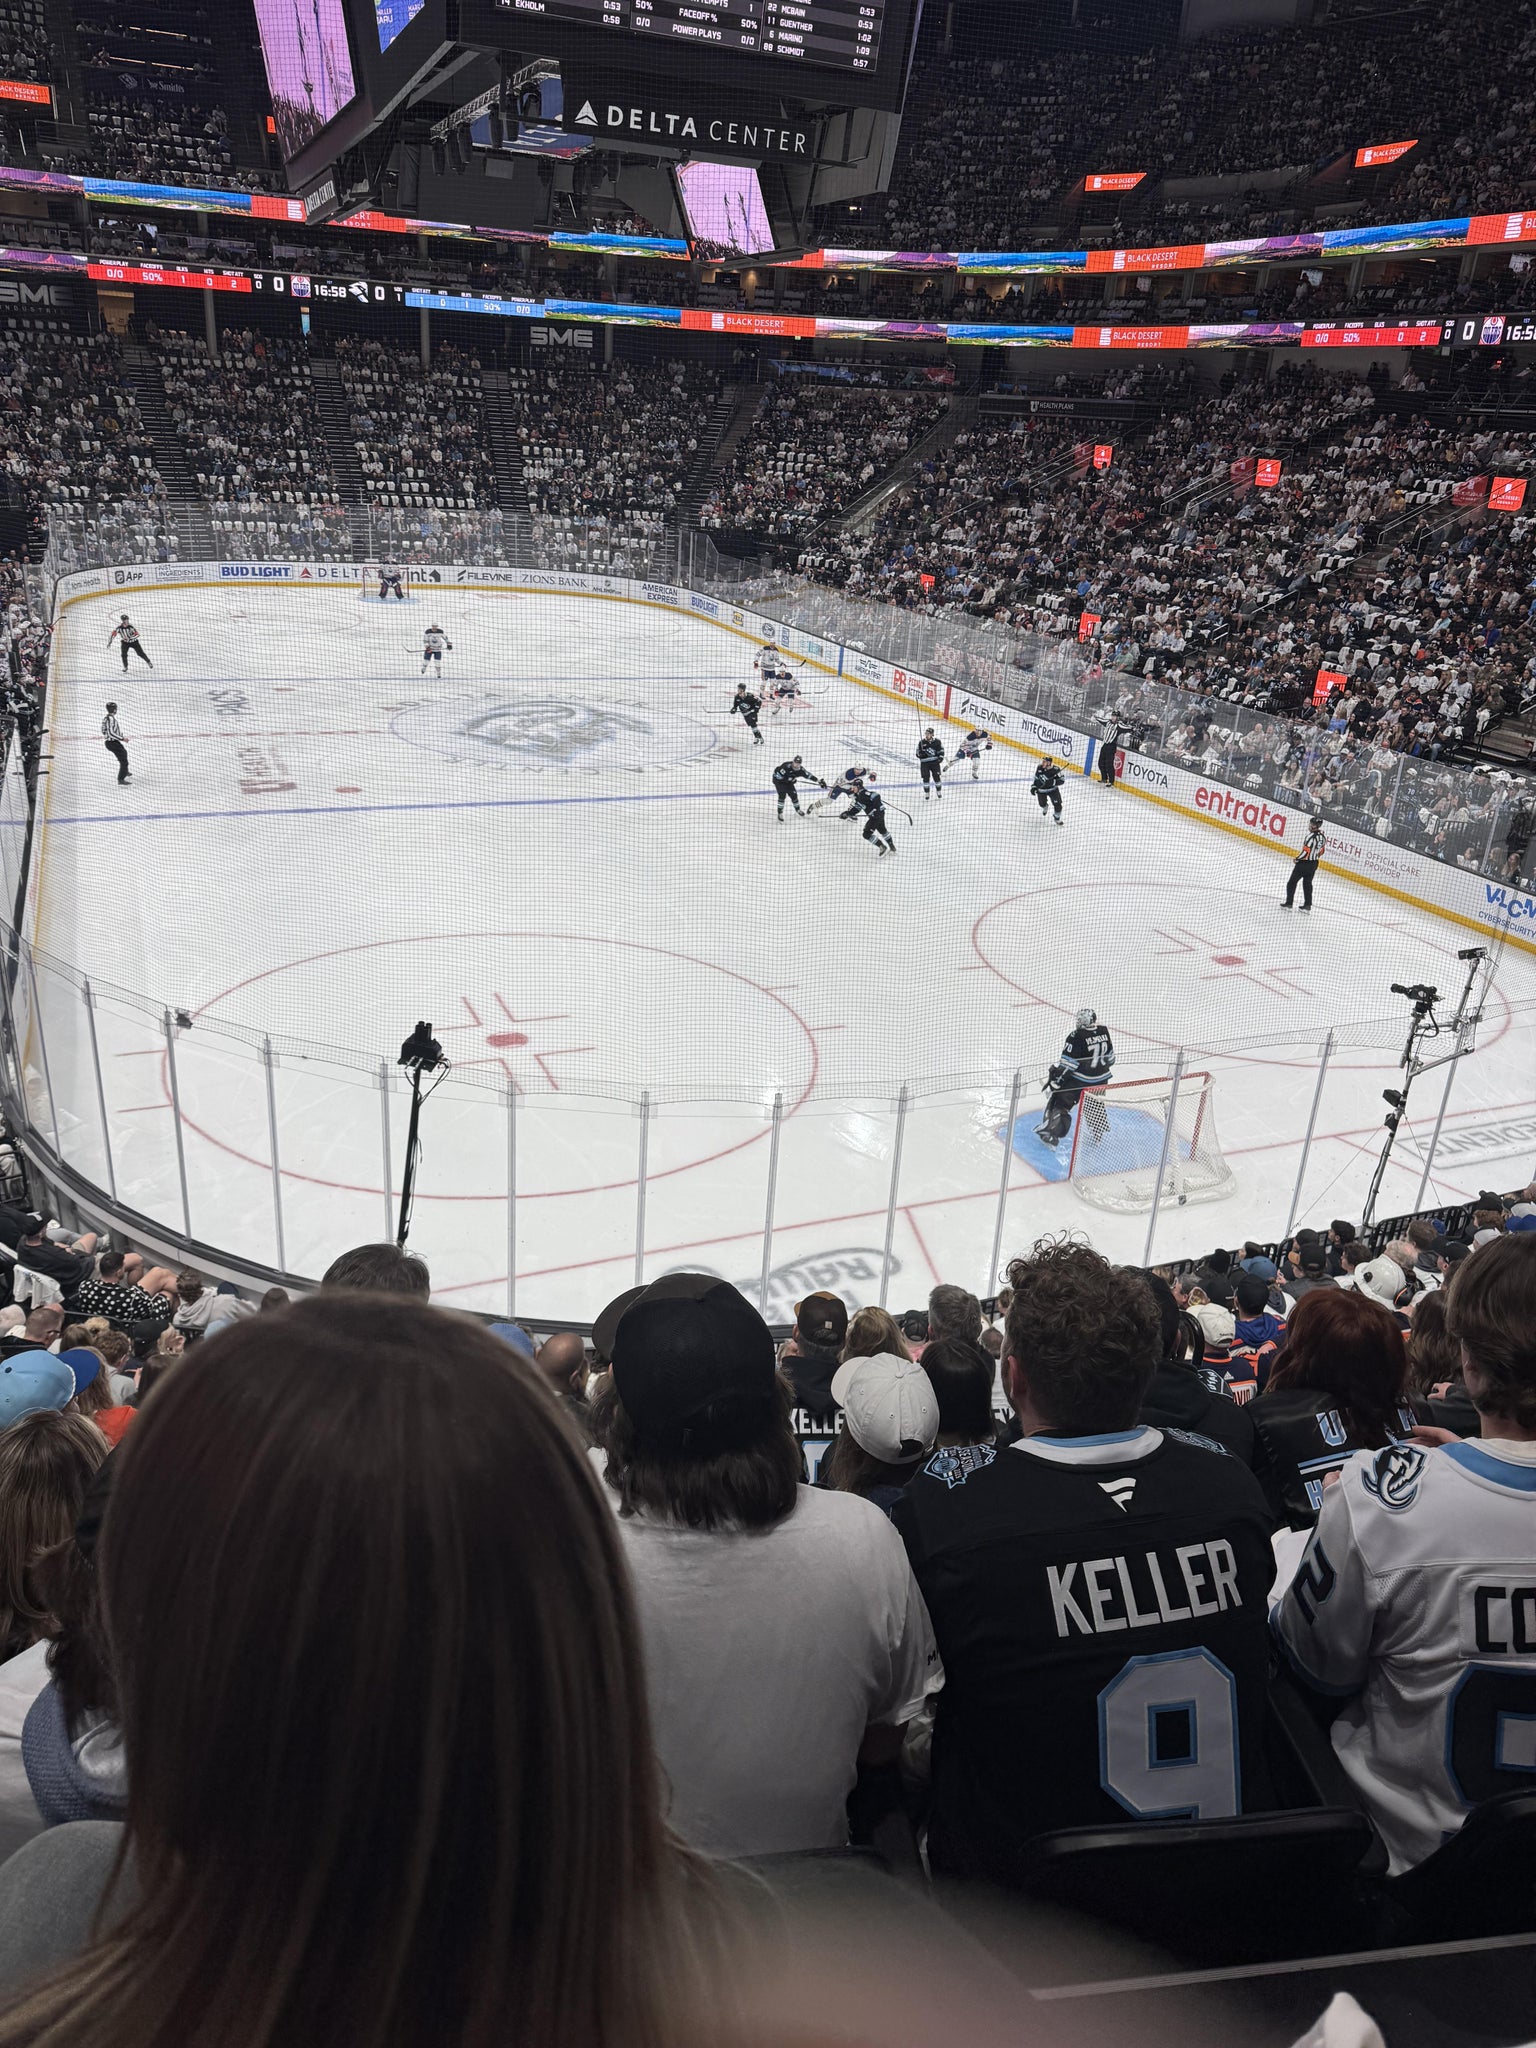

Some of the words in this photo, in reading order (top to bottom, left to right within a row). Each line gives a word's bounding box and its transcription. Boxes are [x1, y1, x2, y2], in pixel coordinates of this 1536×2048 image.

[603, 1, 621, 11] 0:53
[635, 0, 653, 11] 50%
[679, 8, 710, 20] FACEOFF
[741, 19, 758, 29] 50%
[860, 6, 875, 17] 0:53
[603, 15, 620, 25] 0:58
[767, 3, 777, 12] 22
[781, 5, 806, 17] MCBAIN
[858, 20, 873, 30] 0:53
[636, 17, 651, 27] 0/0
[672, 24, 697, 36] POWER
[698, 30, 722, 40] PLAYS
[741, 35, 755, 45] 0/0
[767, 16, 775, 25] 11
[780, 19, 813, 32] GUENTHER
[858, 33, 872, 43] 1:02
[769, 30, 775, 38] 6
[778, 32, 803, 43] MARINO
[856, 46, 870, 55] 1:09
[763, 42, 773, 51] 88
[777, 45, 805, 57] SCHMIDT
[853, 59, 868, 68] 0:57
[607, 105, 697, 138] DELTA
[709, 120, 806, 153] CENTER
[1127, 254, 1152, 263] BLACK
[1152, 252, 1178, 261] DESERT
[106, 269, 124, 279] 0/0
[142, 272, 163, 282] 50%
[255, 281, 262, 289] 0
[273, 277, 284, 292] 0
[313, 284, 347, 298] 16:58
[374, 286, 385, 301] 0
[516, 305, 531, 314] 0/0
[727, 318, 752, 326] BLACK
[754, 319, 784, 328] DESERT
[1462, 321, 1475, 340] 0
[530, 326, 593, 347] SME
[1113, 332, 1137, 340] BLACK
[1138, 332, 1163, 340] DESERT
[1315, 333, 1329, 343] 0/0
[1343, 333, 1360, 342] 50%
[1397, 332, 1405, 341] 0
[1419, 332, 1427, 341] 2
[1444, 329, 1451, 339] 0
[221, 567, 249, 577] BUD
[251, 567, 291, 578] LIGHT
[467, 572, 512, 582] FILEVINE
[522, 574, 555, 584] ZIONS
[558, 578, 588, 588] BANK
[642, 583, 678, 596] AMERICAN
[647, 592, 678, 605] EXPRESS
[691, 596, 703, 609] BUD
[703, 599, 718, 615] LIGHT
[969, 704, 1006, 727] FILEVINE
[1128, 761, 1168, 788] TOYOTA
[1195, 787, 1287, 837] entrata
[1326, 836, 1362, 858] HEALTH
[1364, 860, 1401, 879] PROVIDER
[1366, 852, 1399, 869] OFFICIAL
[1400, 864, 1421, 877] CARE
[790, 1408, 845, 1435] KELLE
[1046, 1538, 1243, 1638] KELLER
[1096, 1645, 1242, 1820] 9
